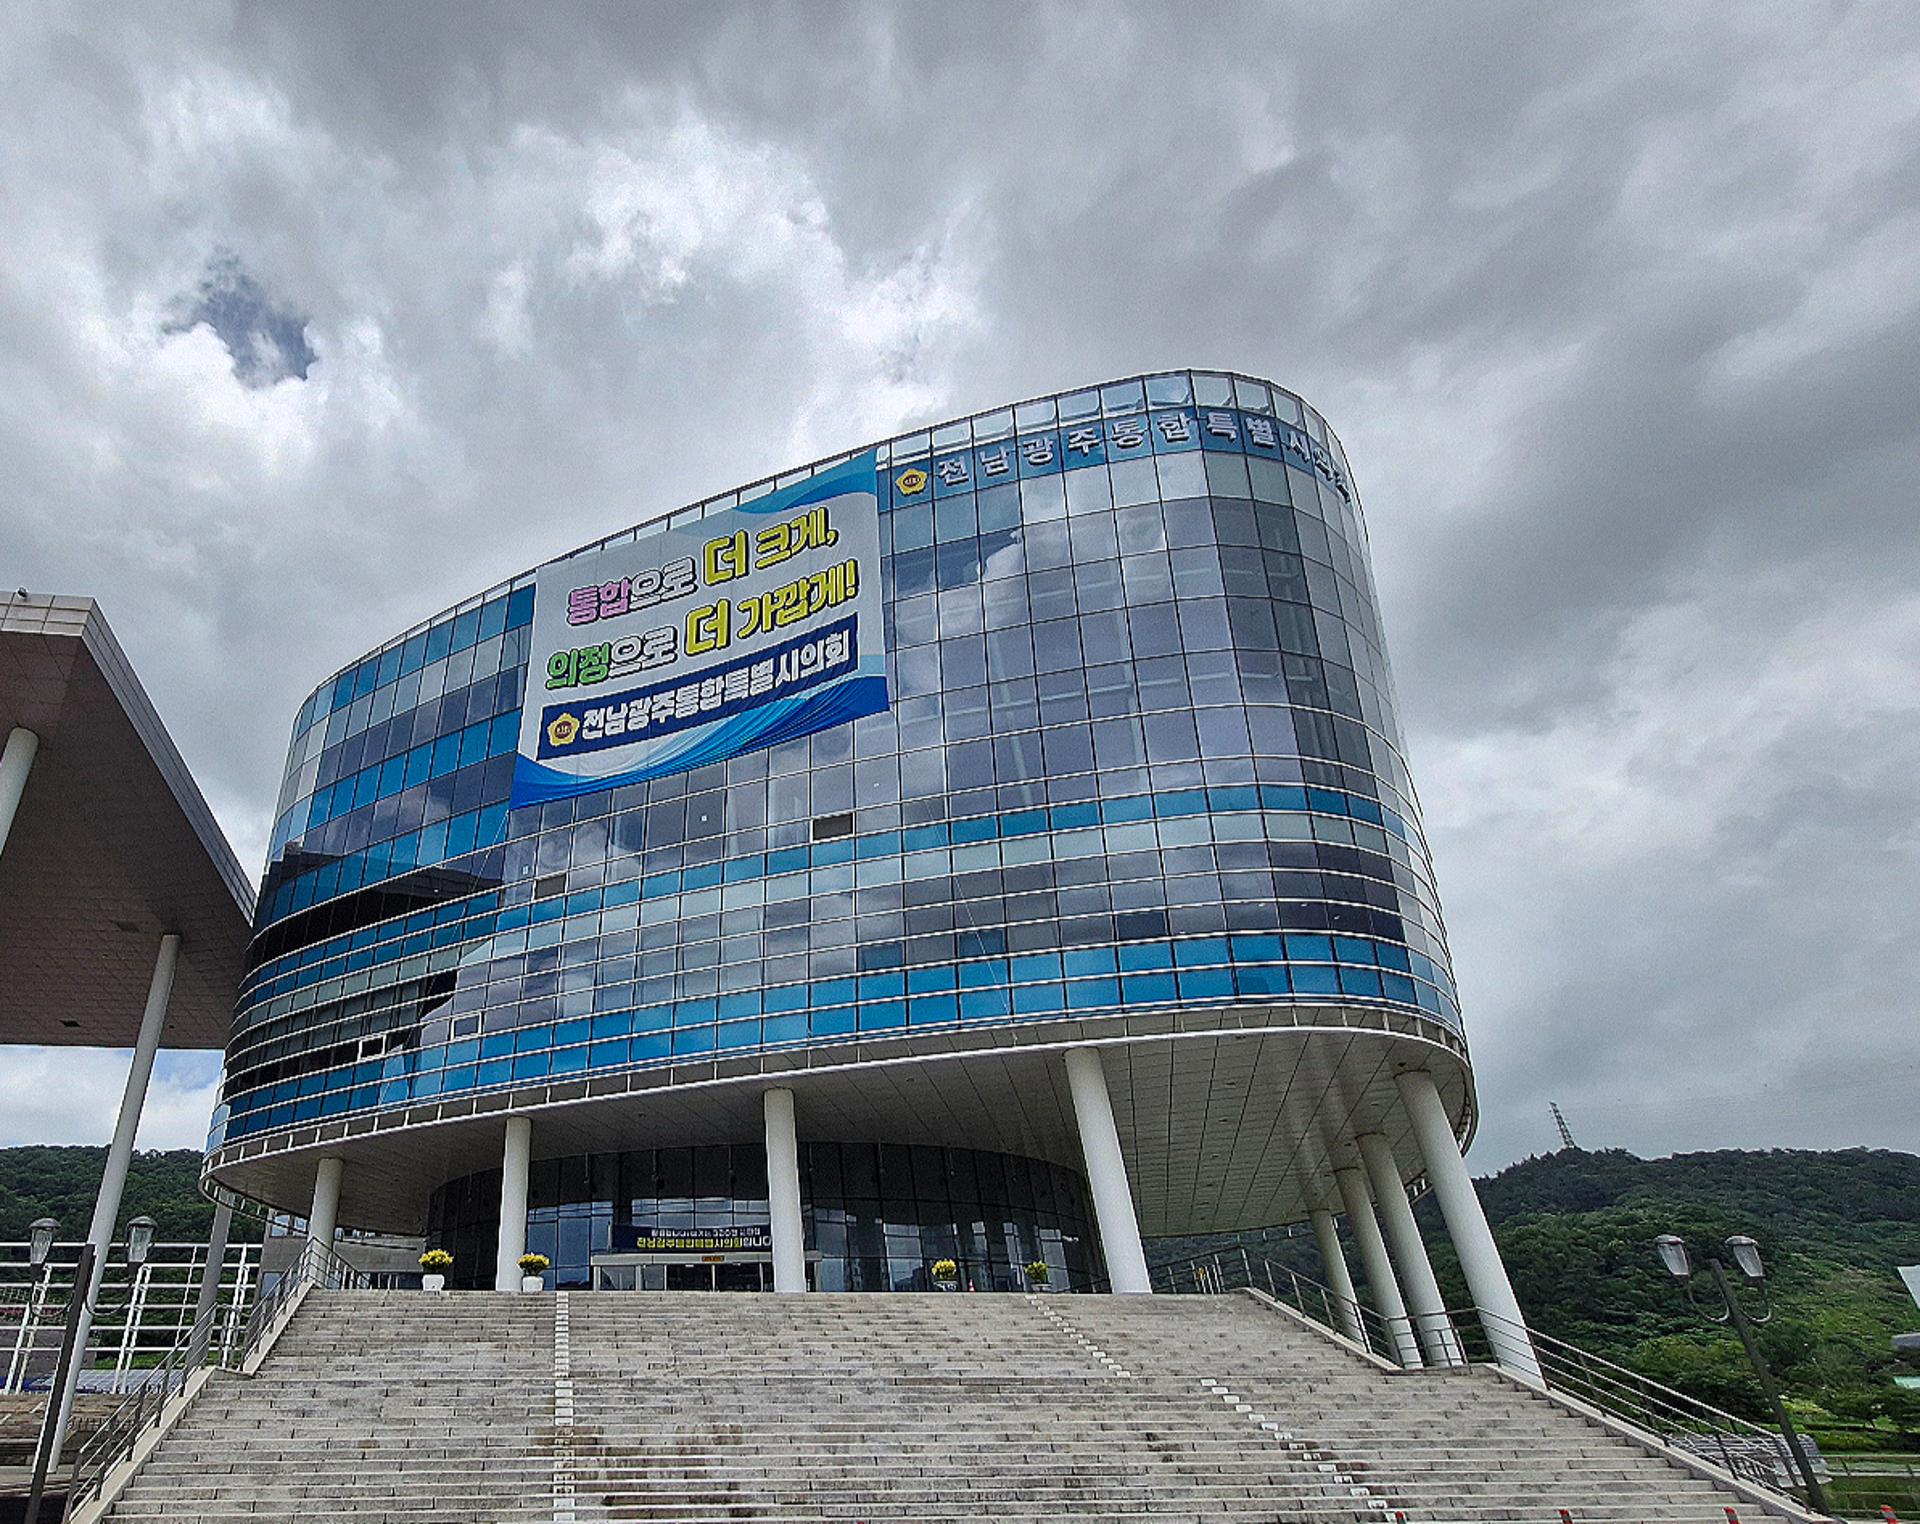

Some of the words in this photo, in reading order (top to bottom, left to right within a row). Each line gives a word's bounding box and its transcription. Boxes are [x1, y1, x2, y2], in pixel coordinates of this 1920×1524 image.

[546, 625, 678, 690] 의정으로
[684, 599, 731, 657] 더
[737, 559, 860, 639] 가깝게!
[567, 557, 698, 626] 통합으로
[703, 531, 748, 587] 더
[756, 507, 839, 570] 크게,
[581, 629, 850, 740] 전남광주통합특별시의회
